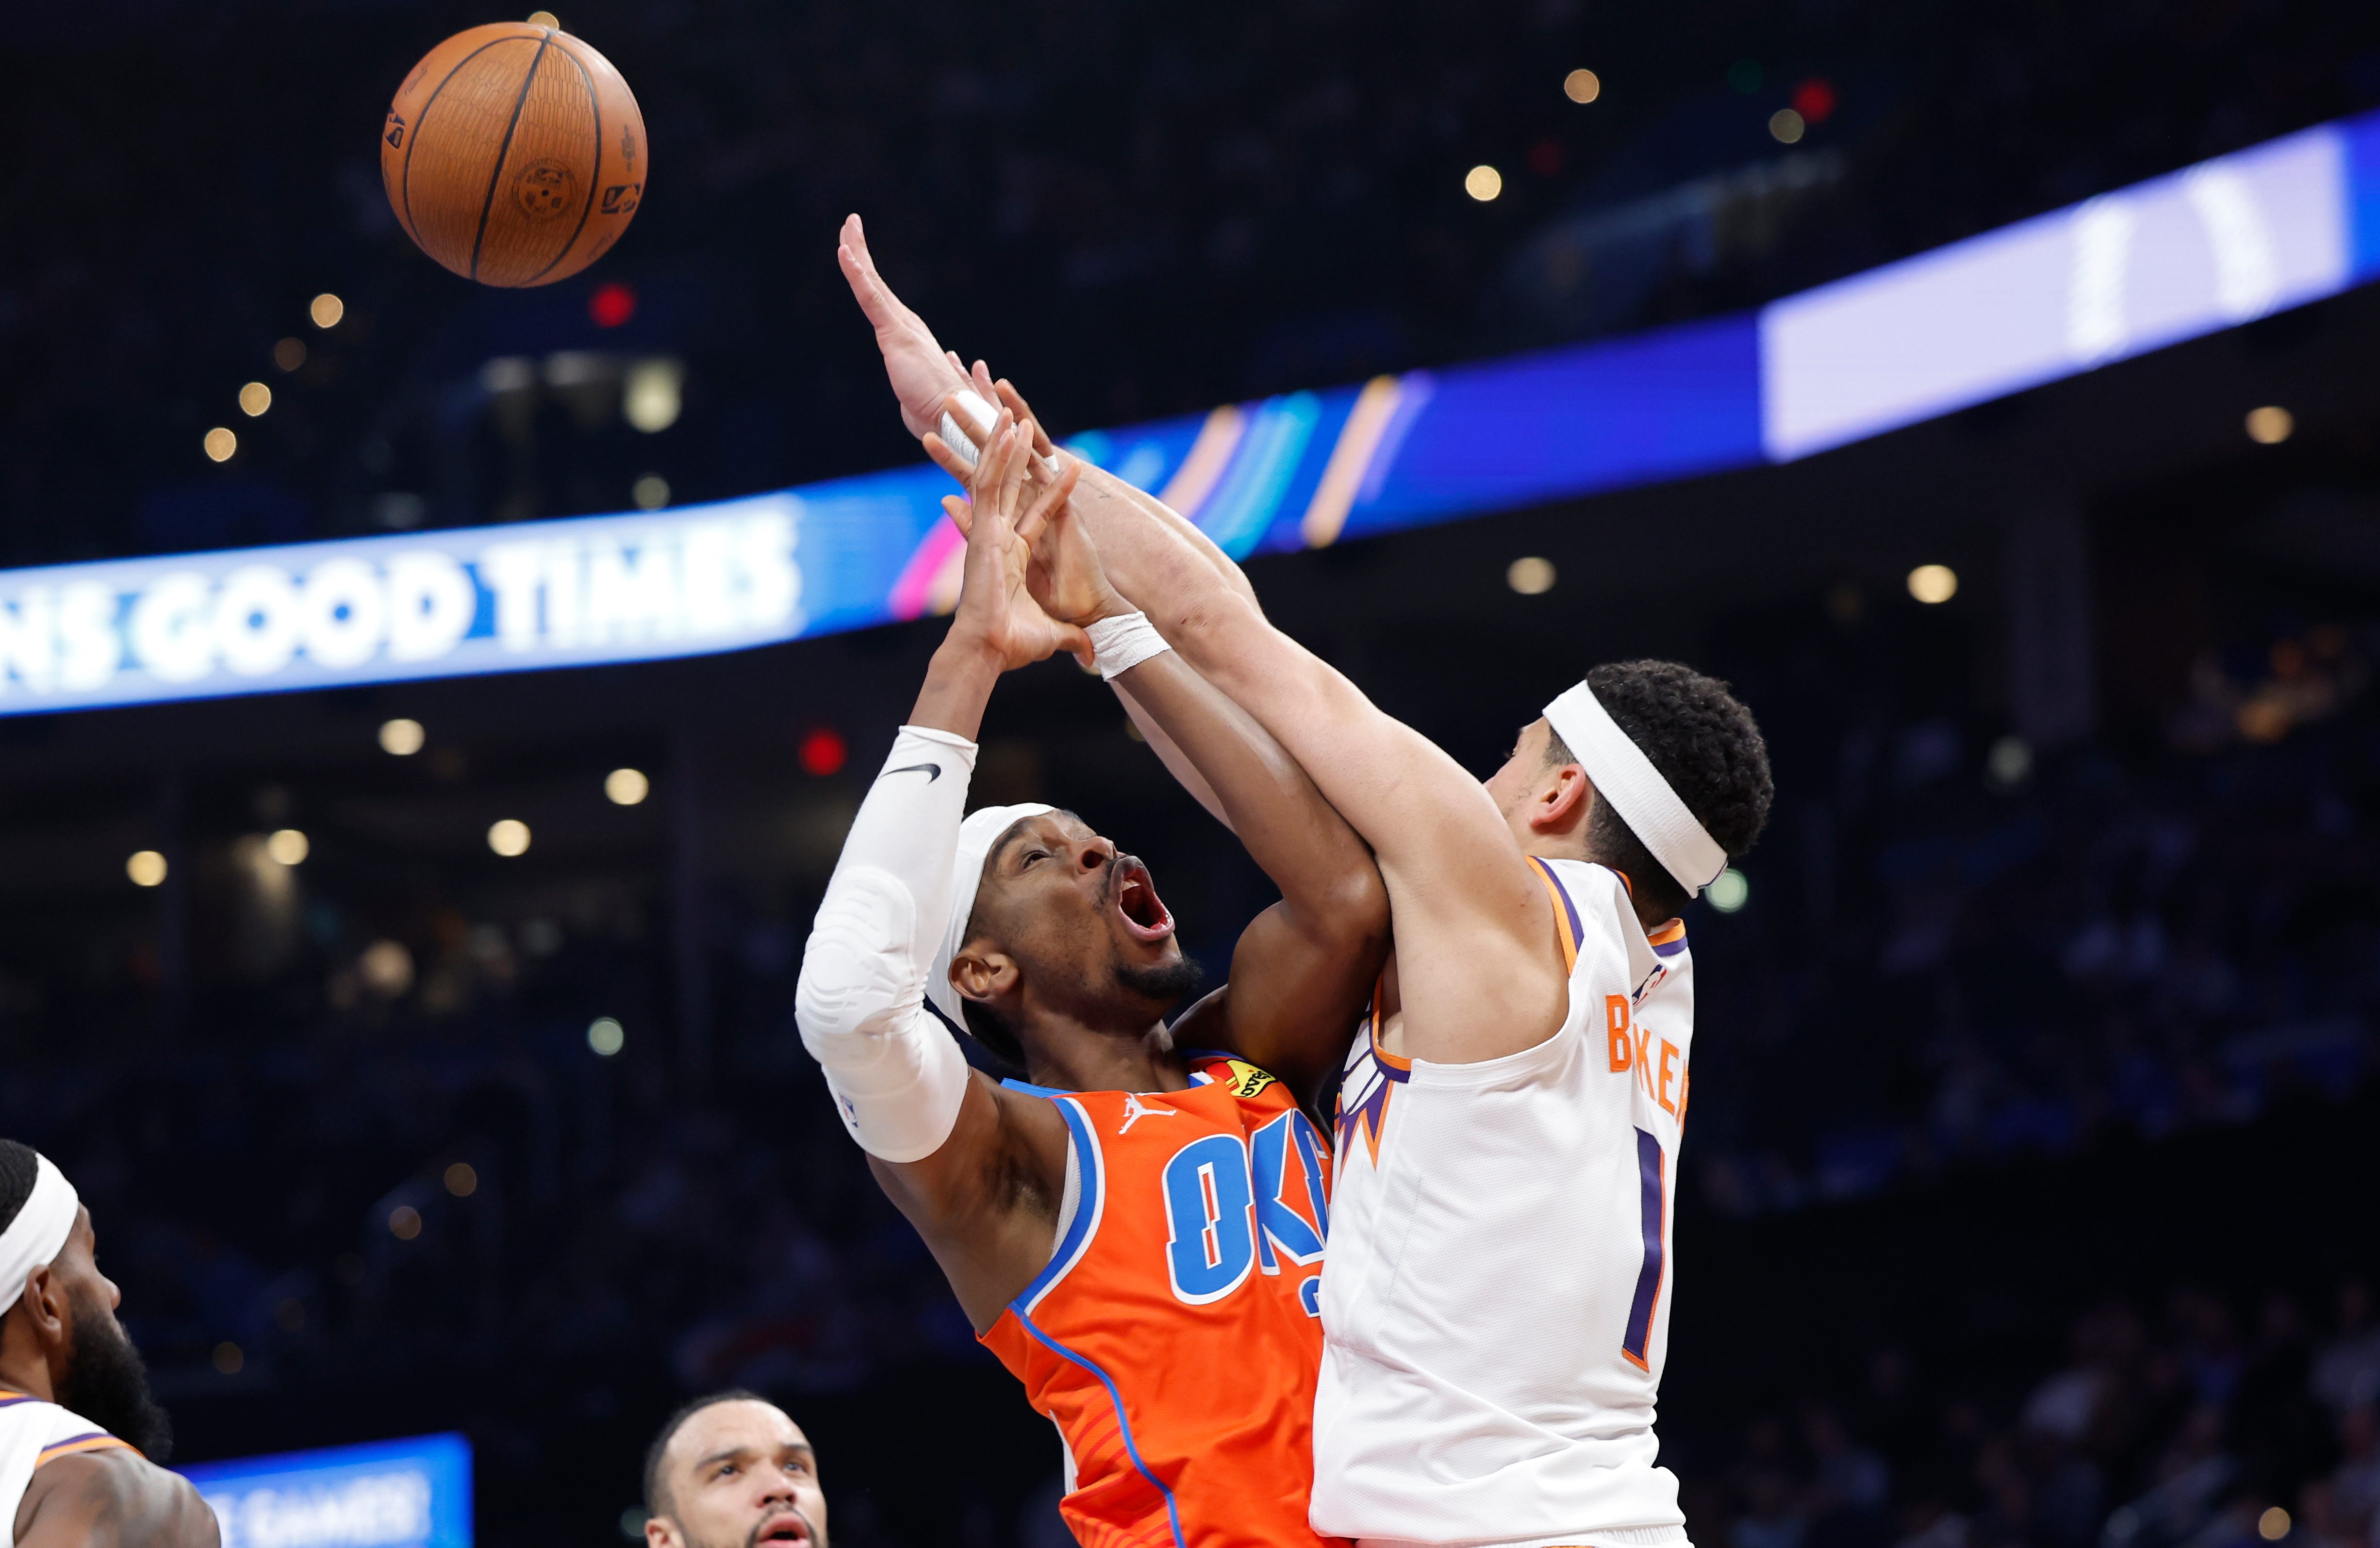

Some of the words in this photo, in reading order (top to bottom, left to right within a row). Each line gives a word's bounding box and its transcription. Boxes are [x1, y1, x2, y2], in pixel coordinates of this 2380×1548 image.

[132, 548, 471, 683] GOOD
[480, 507, 797, 653] TIMES
[1622, 1125, 1666, 1373] 1
